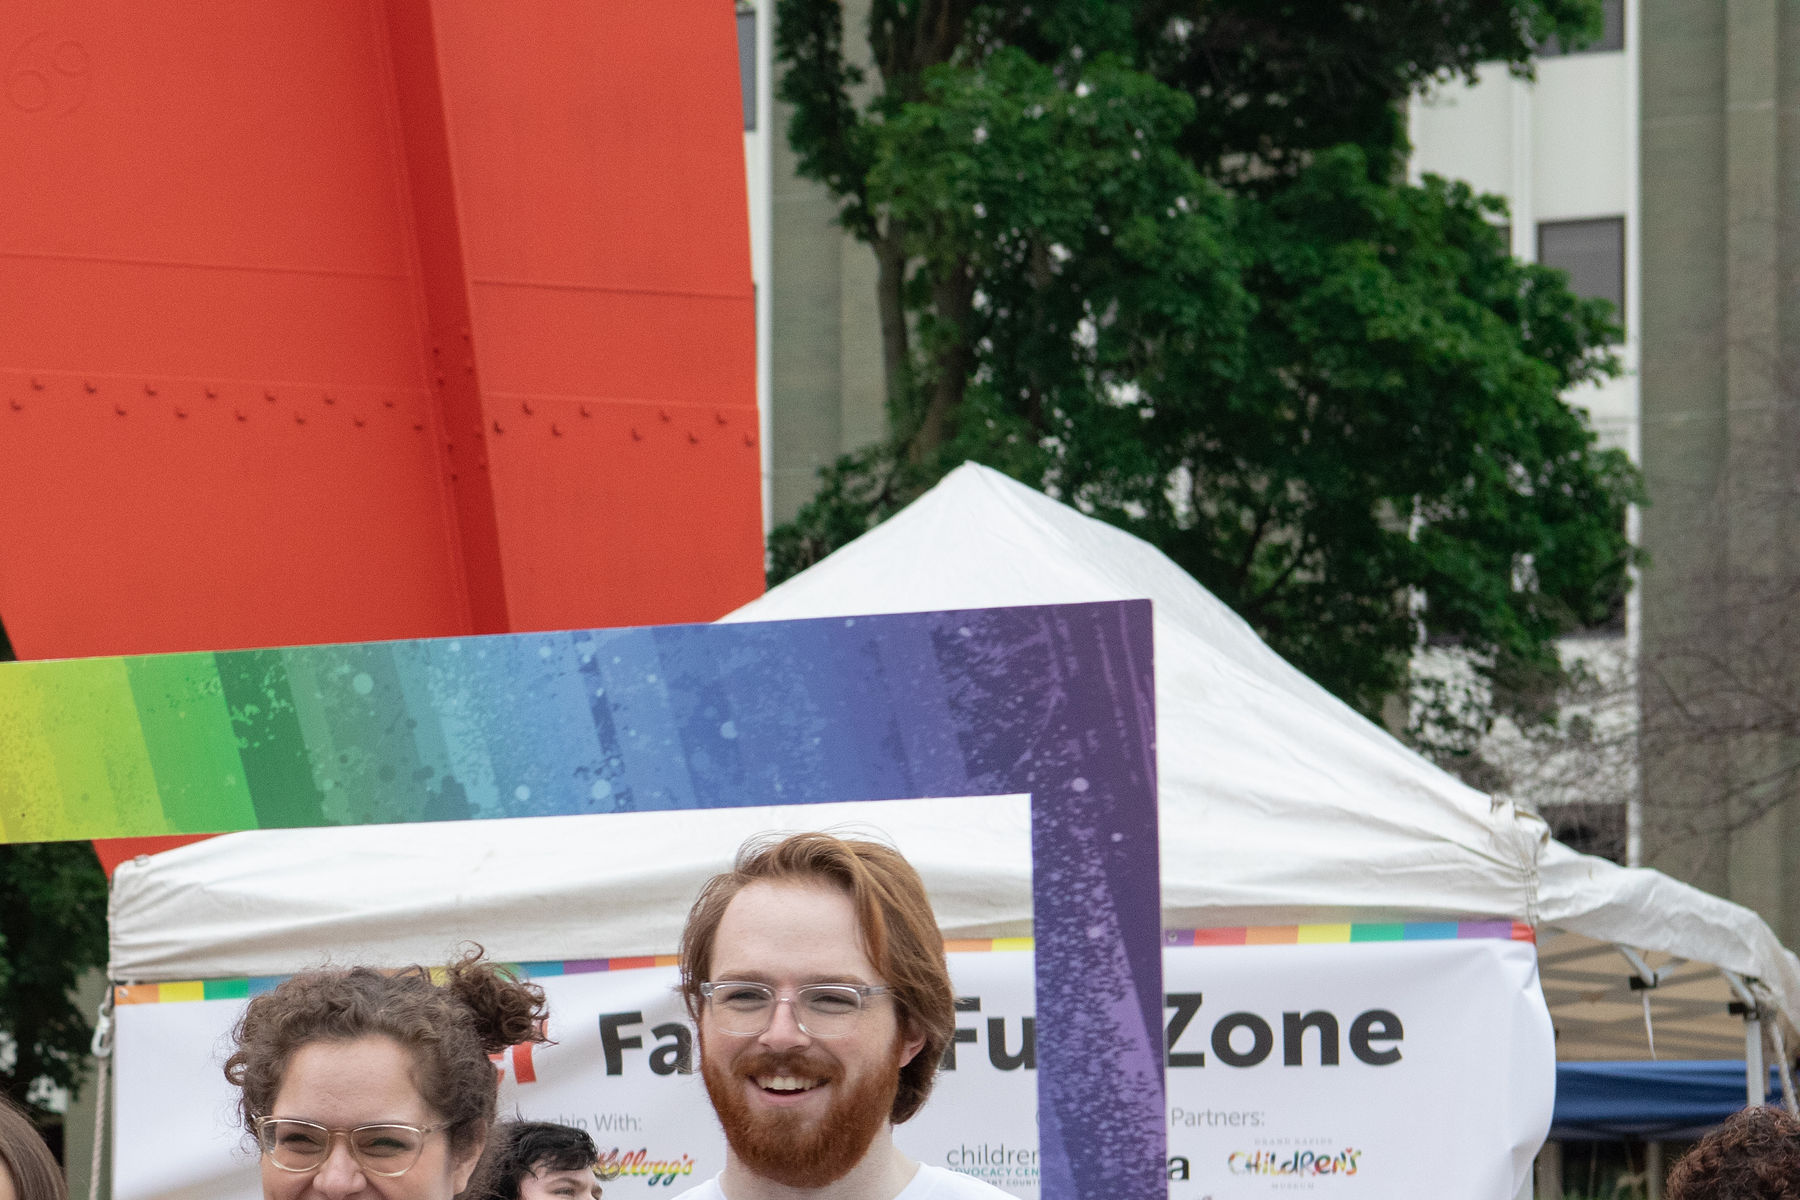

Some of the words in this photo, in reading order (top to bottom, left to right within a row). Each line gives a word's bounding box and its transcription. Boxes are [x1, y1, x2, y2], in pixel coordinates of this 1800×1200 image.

[599, 1011, 693, 1076] Fa
[939, 996, 1037, 1071] Fu
[1164, 993, 1406, 1068] Zone
[594, 1113, 642, 1131] With:
[1171, 1107, 1265, 1128] Partners:
[946, 1143, 1039, 1166] childre
